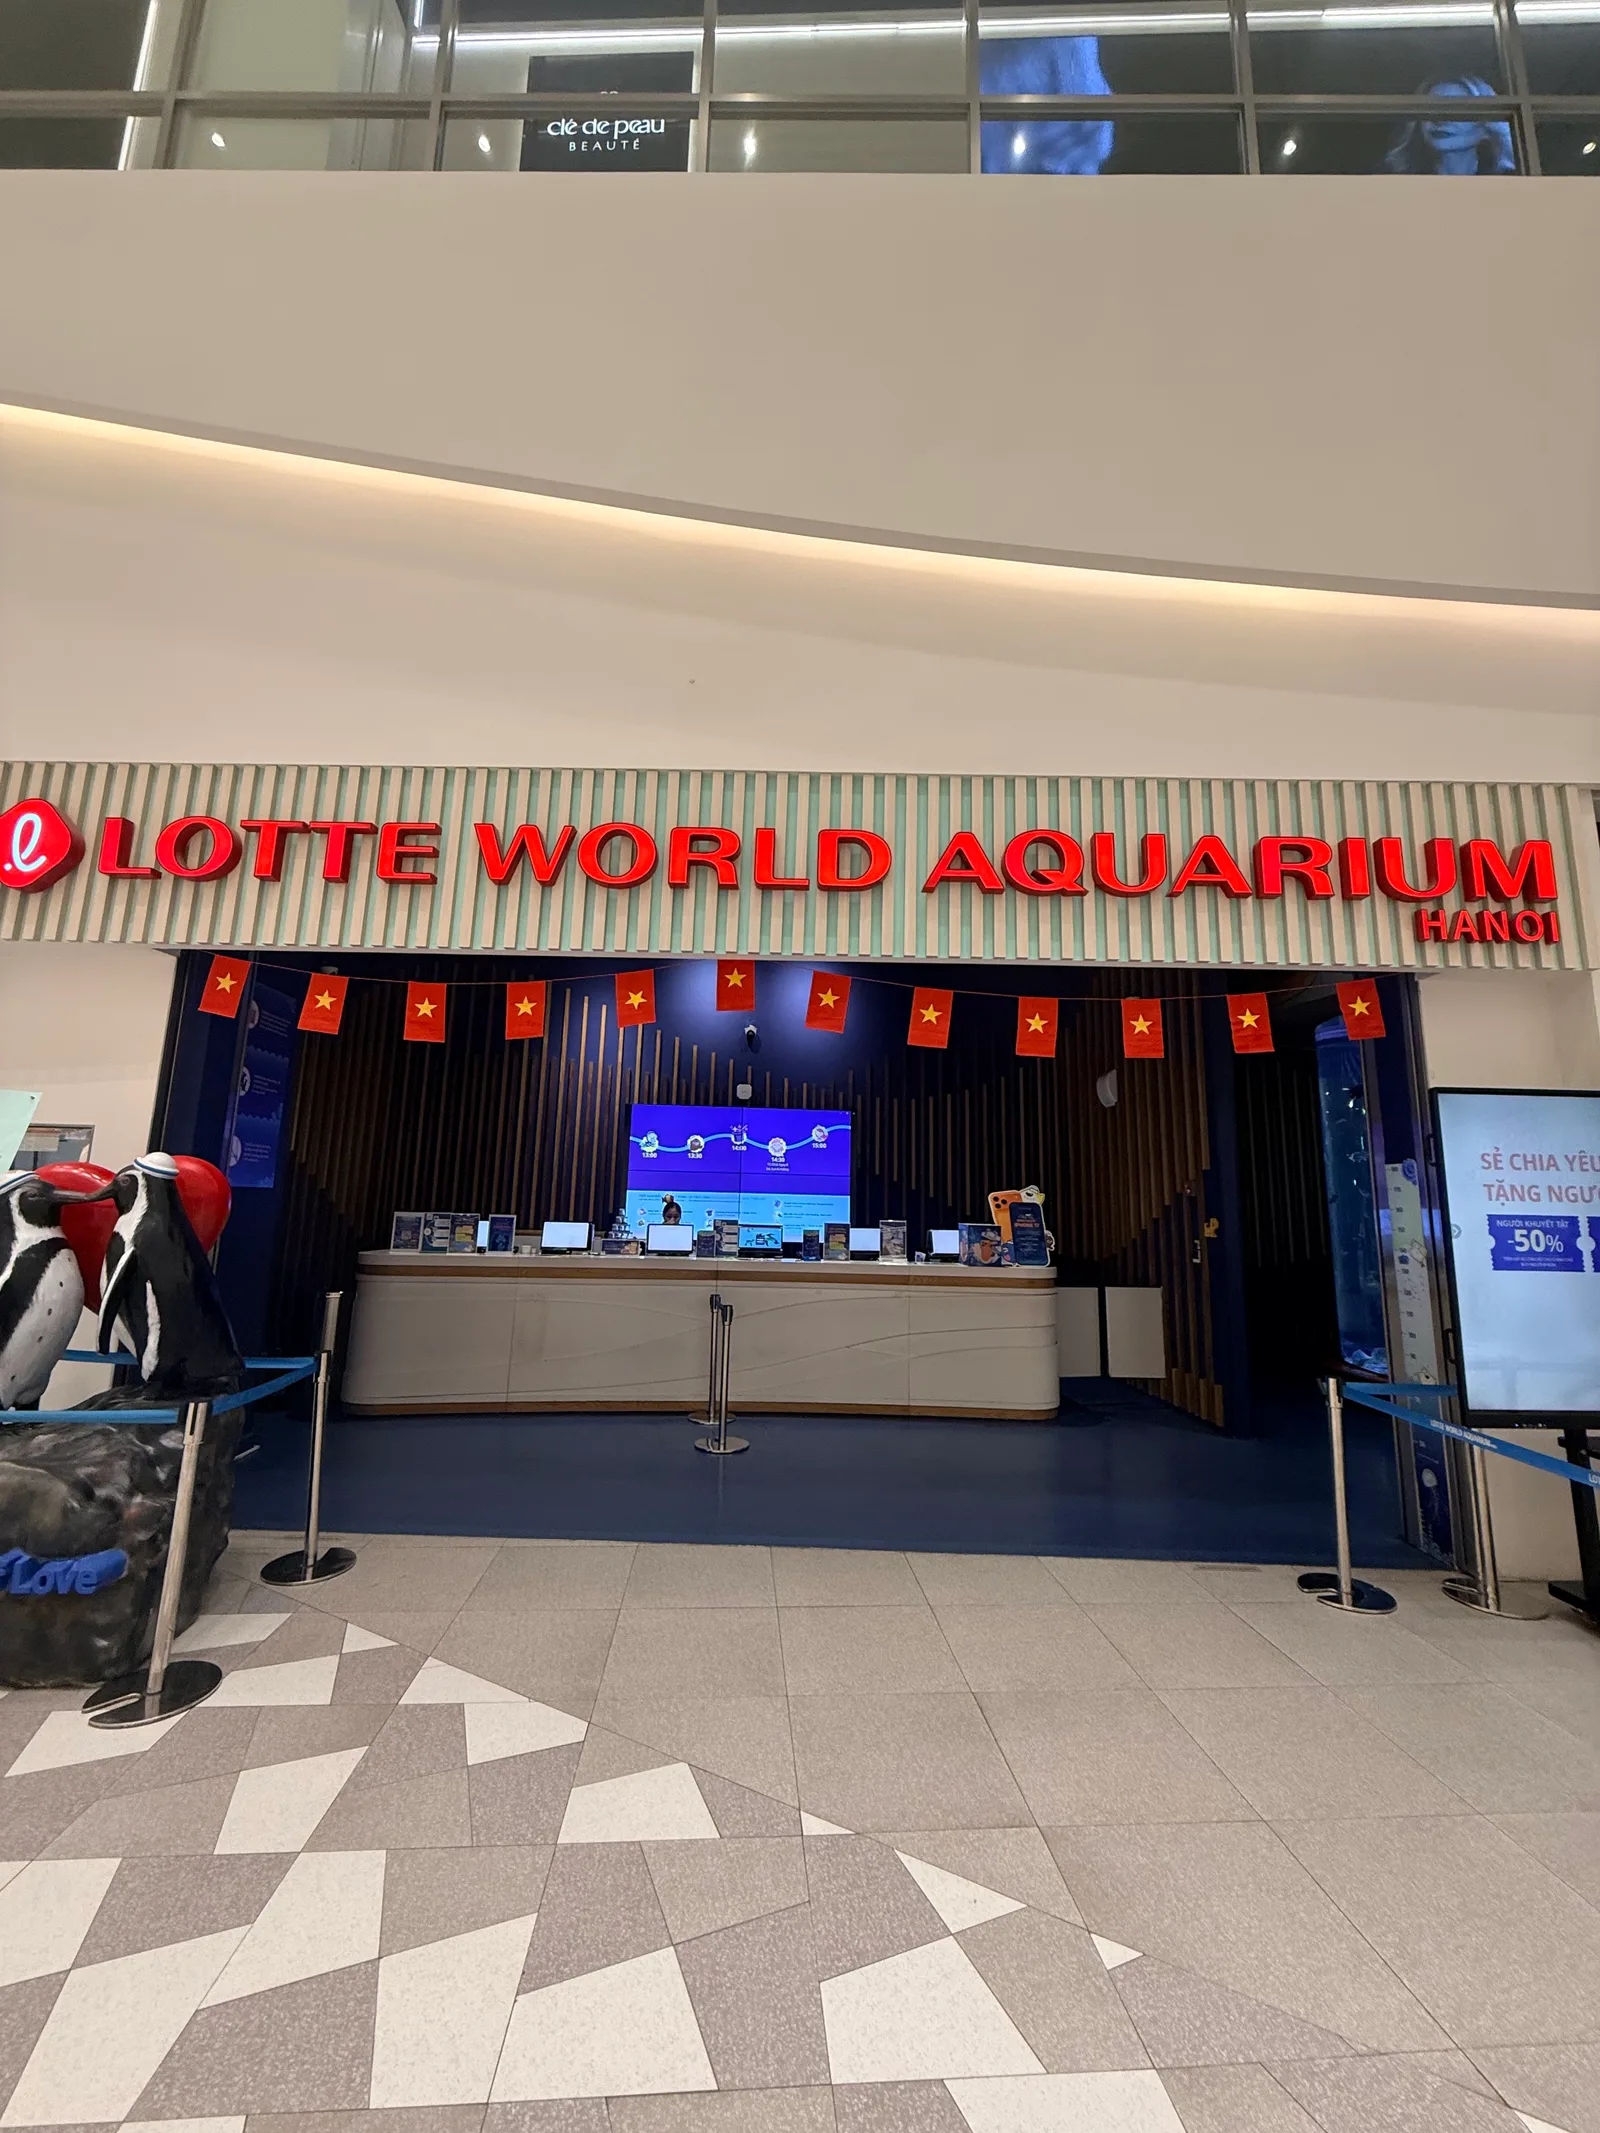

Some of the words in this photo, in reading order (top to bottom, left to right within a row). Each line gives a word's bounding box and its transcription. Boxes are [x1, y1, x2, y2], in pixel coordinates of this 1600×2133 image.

[547, 118, 578, 135] clé
[582, 118, 609, 135] de
[614, 118, 665, 139] peau
[568, 137, 640, 152] BEAUTÉ
[98, 815, 441, 884] LOTTE
[474, 822, 892, 892] WORLD
[921, 828, 1559, 903] AQUARIUM
[1416, 908, 1560, 945] HANOI
[1481, 1146, 1504, 1171] SẺ
[1509, 1153, 1561, 1171] CHIA
[1564, 1150, 1600, 1173] YÊU
[1483, 1178, 1542, 1206] TẶNG
[1547, 1184, 1600, 1204] NGƯ
[1507, 1229, 1564, 1252] -50%
